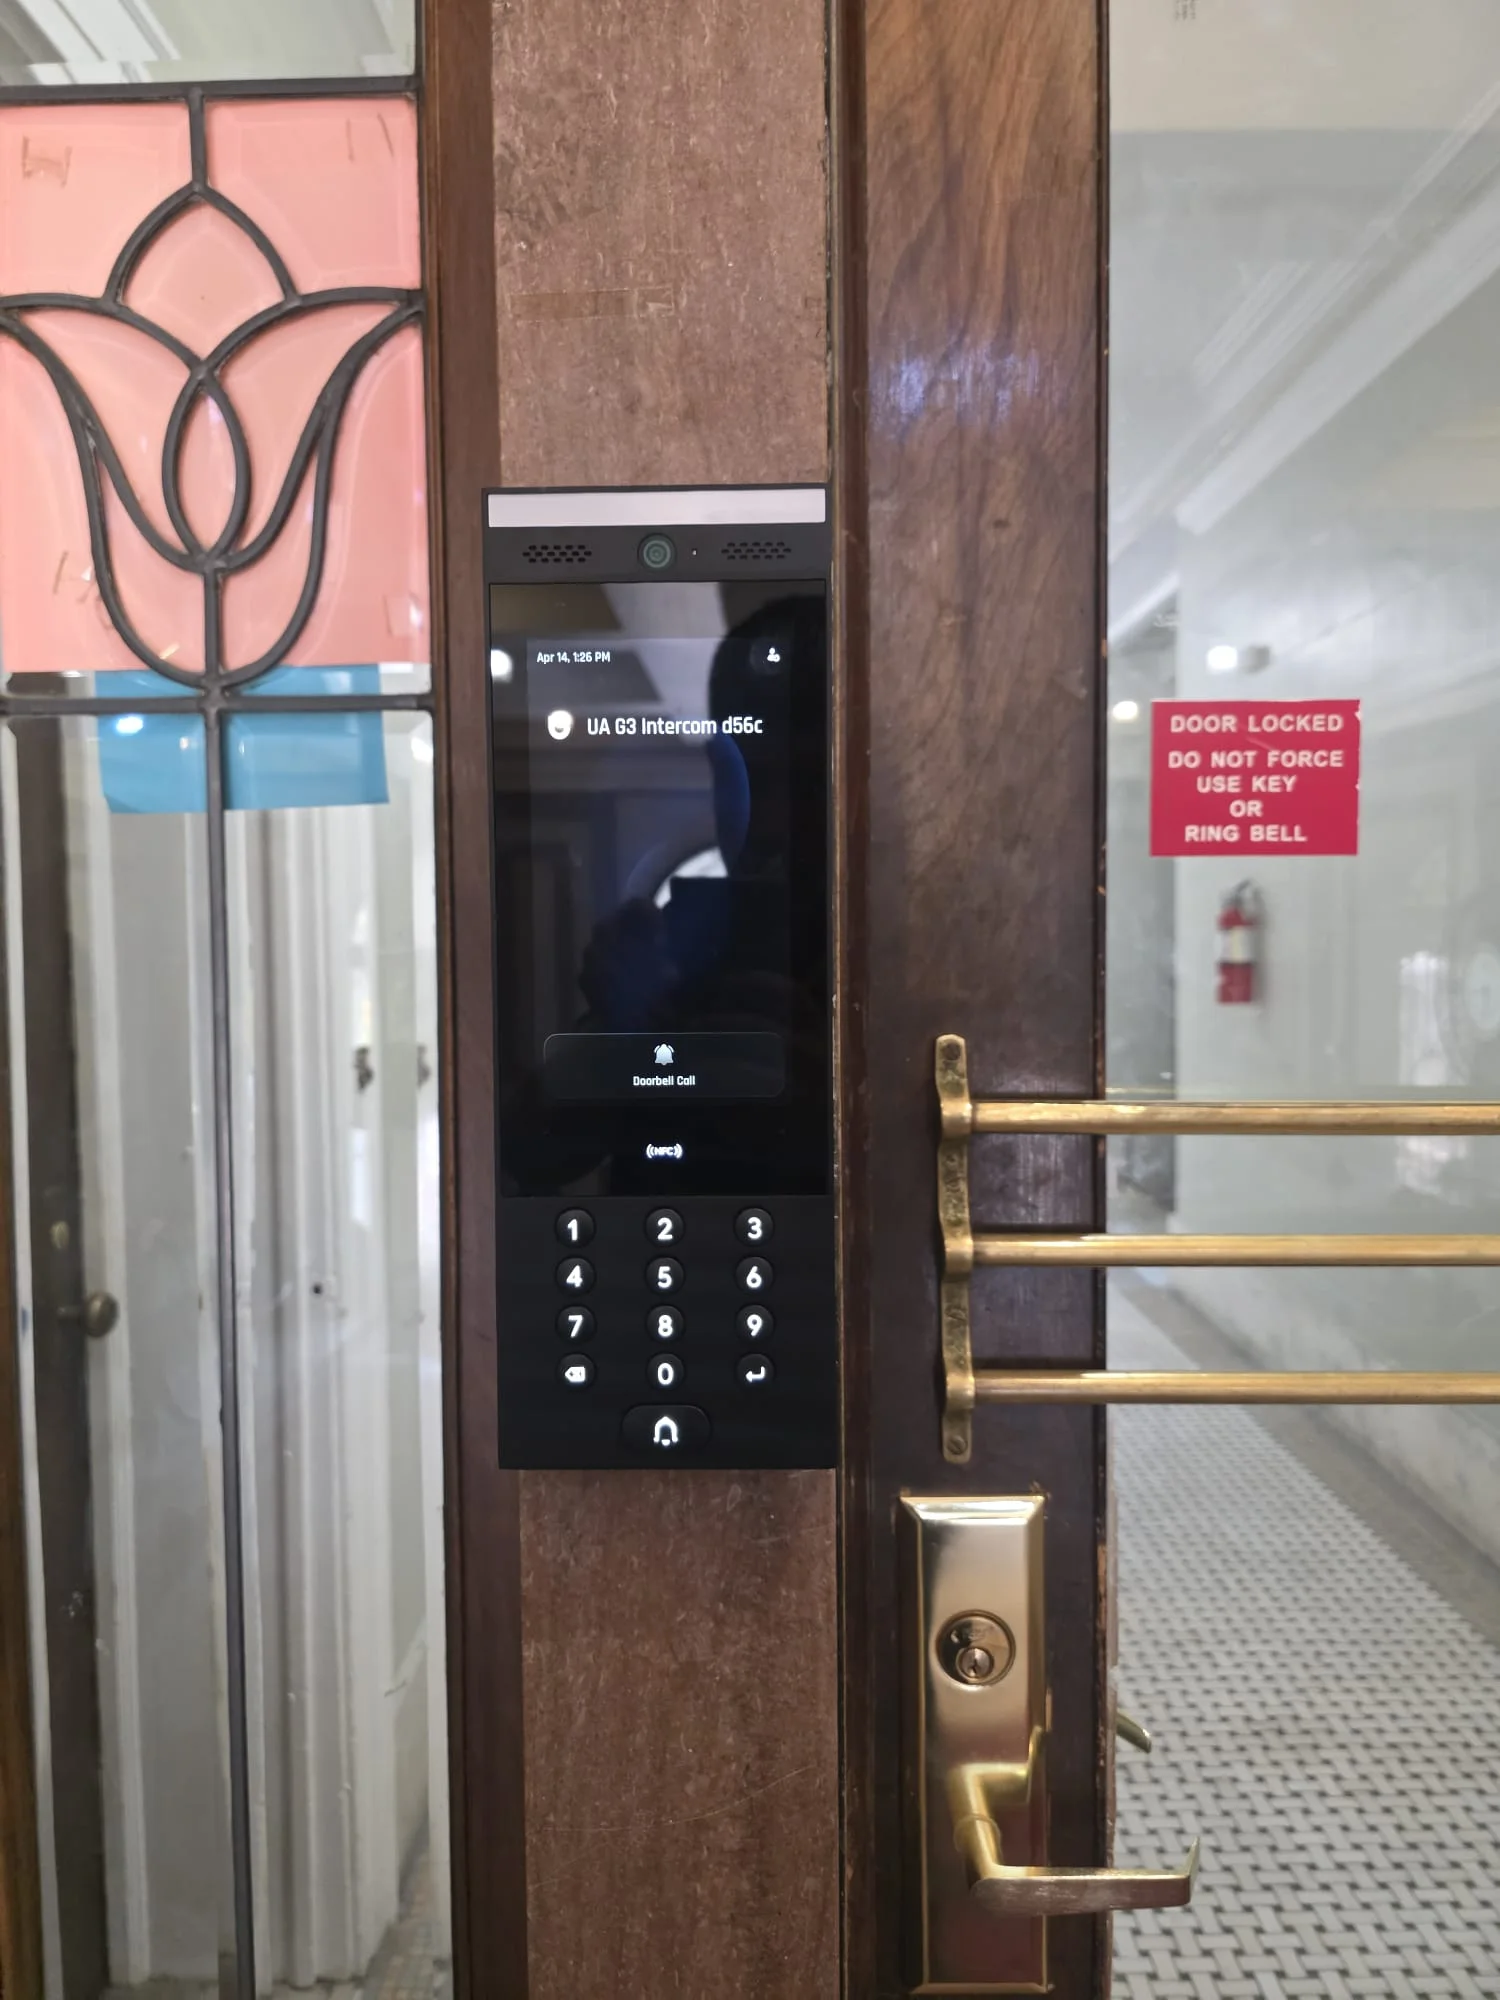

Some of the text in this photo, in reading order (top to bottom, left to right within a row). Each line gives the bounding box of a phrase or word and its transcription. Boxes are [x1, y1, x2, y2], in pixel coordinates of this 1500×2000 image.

[536, 650, 611, 665] Apr 14, 1:26 PM
[587, 715, 763, 736] UA G3 Intercom d56c
[1170, 713, 1344, 733] DOOR LOCKED
[1168, 749, 1343, 769] DO NOT FORCE
[1196, 774, 1297, 794] USE KEY
[1229, 799, 1263, 818] OR
[1184, 824, 1307, 843] RING BELL
[632, 1075, 696, 1086] Doorbell Call
[567, 1216, 763, 1241] 1 2 3
[566, 1264, 763, 1289] 4 5 6
[568, 1313, 763, 1338] 7 8 9
[657, 1362, 675, 1386] 0
